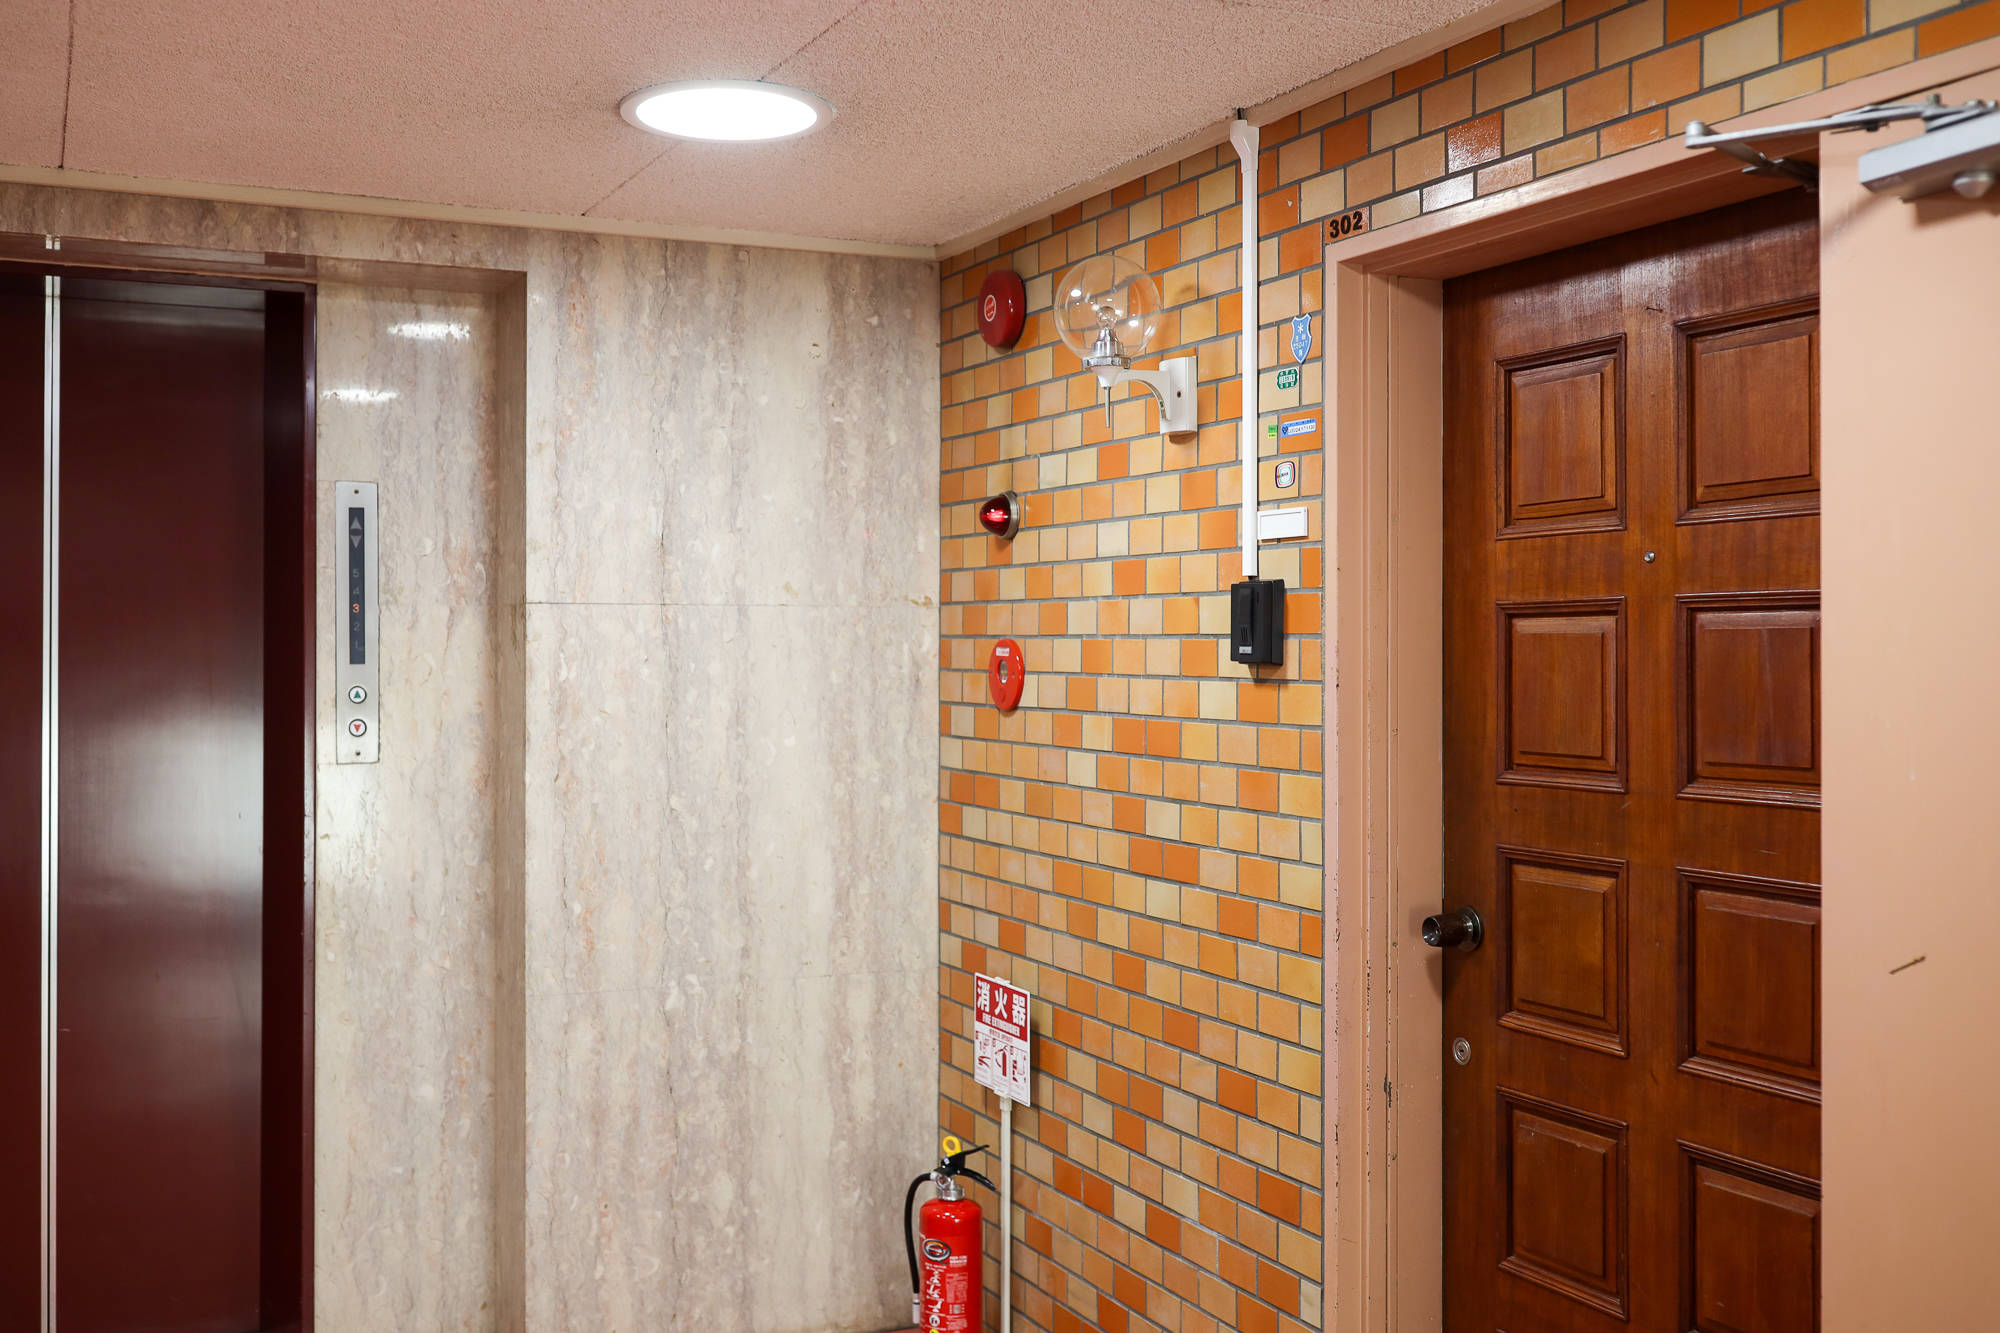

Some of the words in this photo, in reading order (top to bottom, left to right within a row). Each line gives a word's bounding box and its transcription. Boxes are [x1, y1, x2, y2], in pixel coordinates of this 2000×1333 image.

[1330, 211, 1362, 238] 302
[352, 568, 360, 578] 5
[352, 603, 360, 614] 3
[353, 622, 360, 632] 2
[977, 980, 1026, 1027] 消火器
